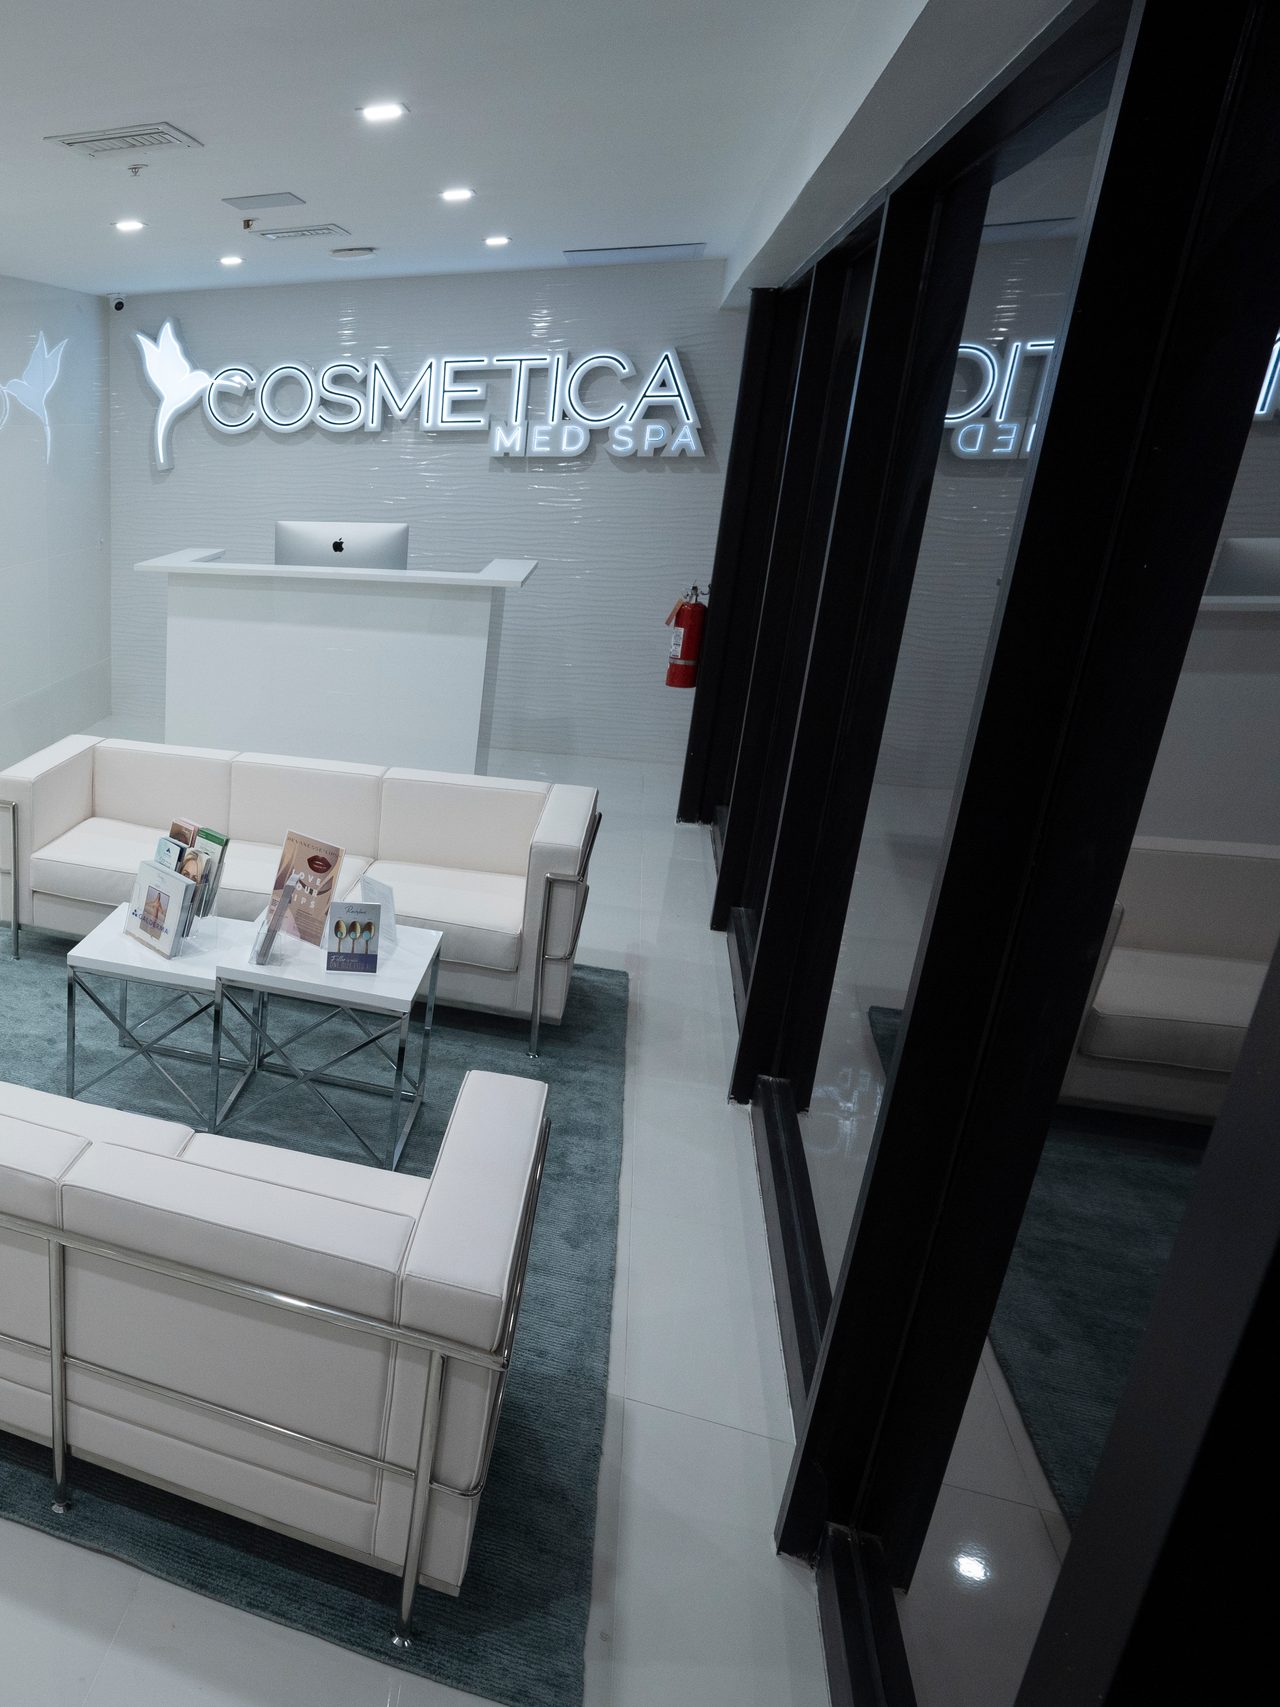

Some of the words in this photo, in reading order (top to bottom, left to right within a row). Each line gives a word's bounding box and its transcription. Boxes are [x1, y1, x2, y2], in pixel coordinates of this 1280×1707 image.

[206, 350, 696, 431] COSMETICA
[494, 424, 586, 452] MED
[611, 424, 697, 452] SPA
[291, 893, 316, 909] IPS
[296, 883, 318, 897] OUR
